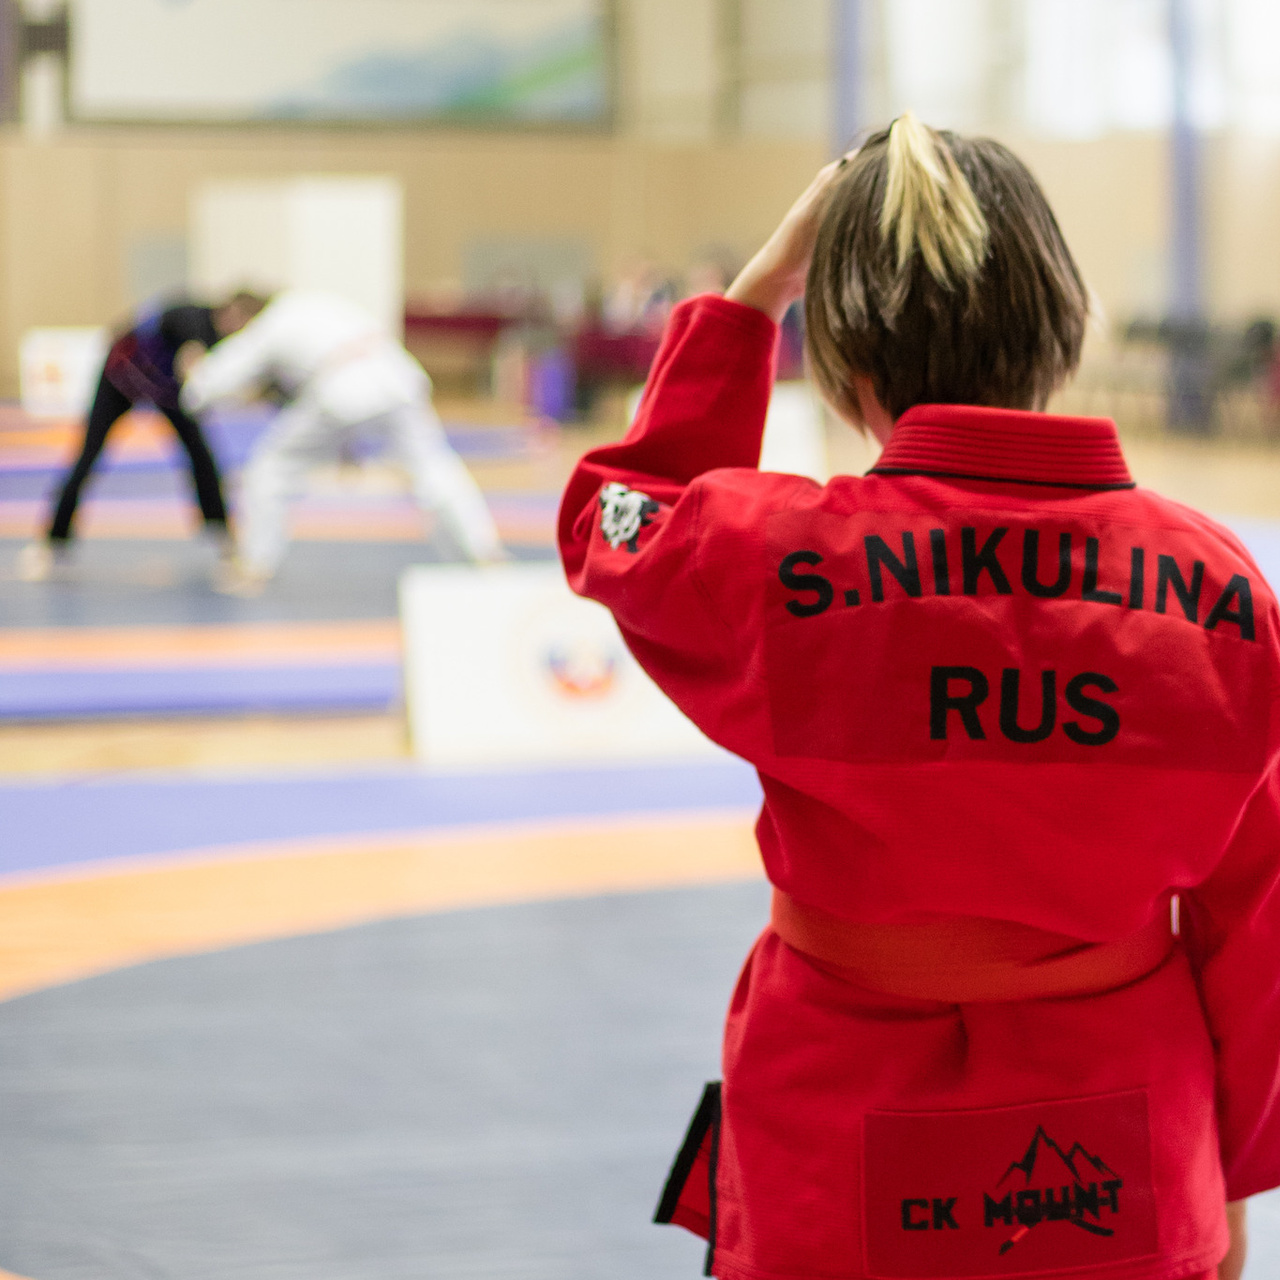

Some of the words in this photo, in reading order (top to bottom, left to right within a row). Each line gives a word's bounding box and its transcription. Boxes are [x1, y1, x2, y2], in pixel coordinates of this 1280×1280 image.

[778, 527, 1256, 641] S.NIKULINA
[929, 666, 1121, 747] RUS
[983, 1179, 1123, 1227] MOUNT
